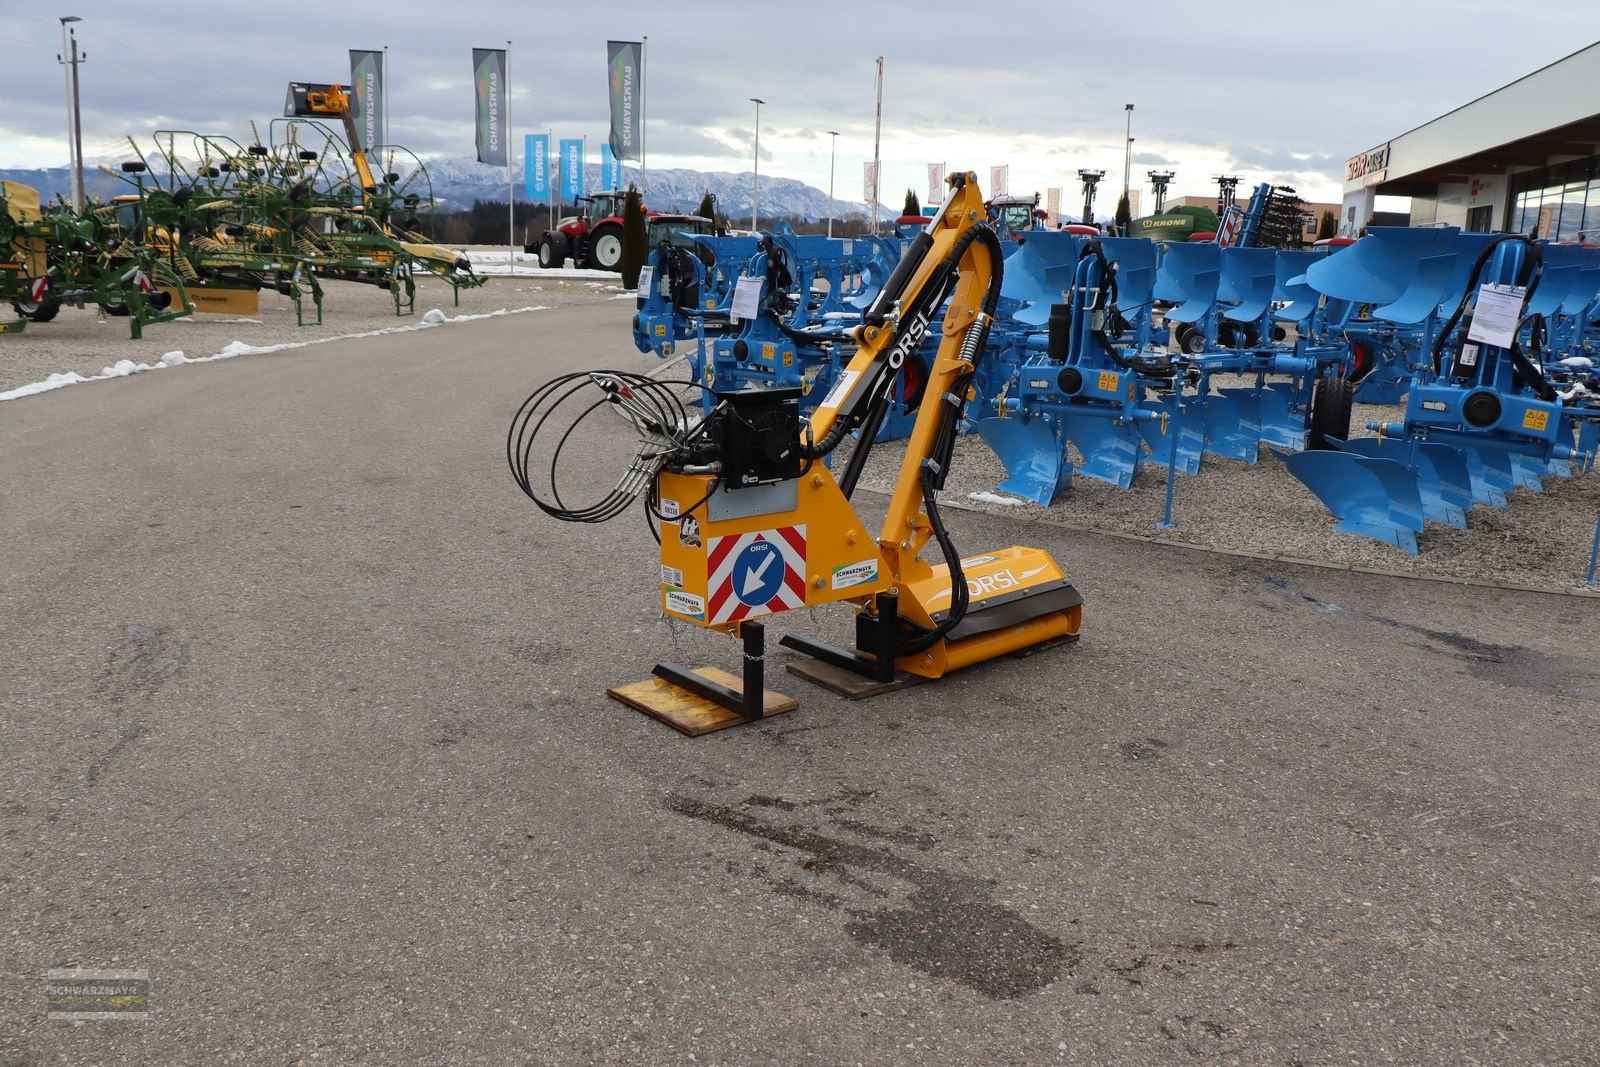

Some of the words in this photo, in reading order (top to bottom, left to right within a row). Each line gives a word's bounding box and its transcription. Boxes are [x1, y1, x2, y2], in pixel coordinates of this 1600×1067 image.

[888, 311, 929, 369] ORSI
[750, 544, 768, 552] ORSI
[836, 565, 872, 578] SCHWARZMAYR
[967, 568, 1020, 596] ORSI
[668, 592, 699, 607] SCHWARZMAYR
